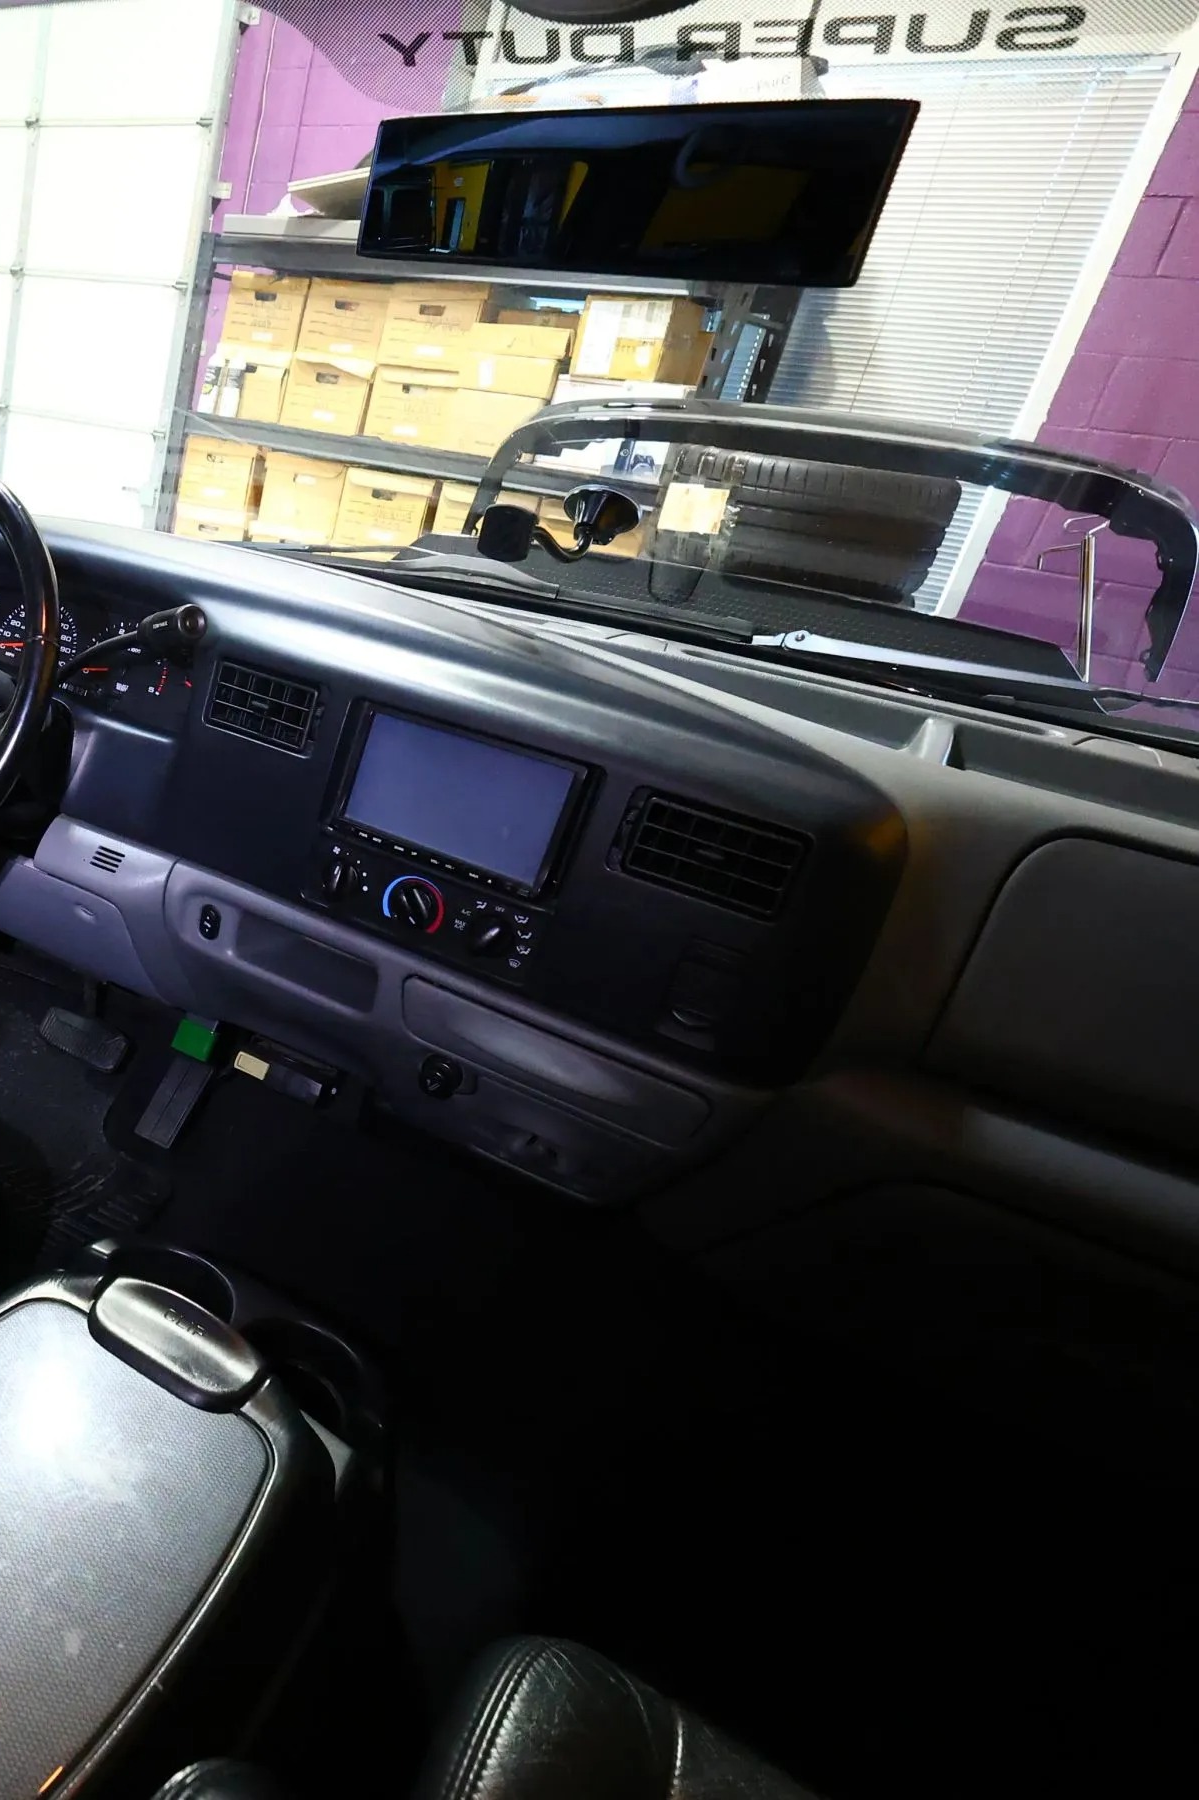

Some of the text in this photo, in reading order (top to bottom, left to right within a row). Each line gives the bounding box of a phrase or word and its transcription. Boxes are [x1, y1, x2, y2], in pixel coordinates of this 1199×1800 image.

[10, 619, 21, 627] 20
[3, 630, 12, 638] 10
[60, 634, 72, 642] 80
[59, 646, 71, 654] 90
